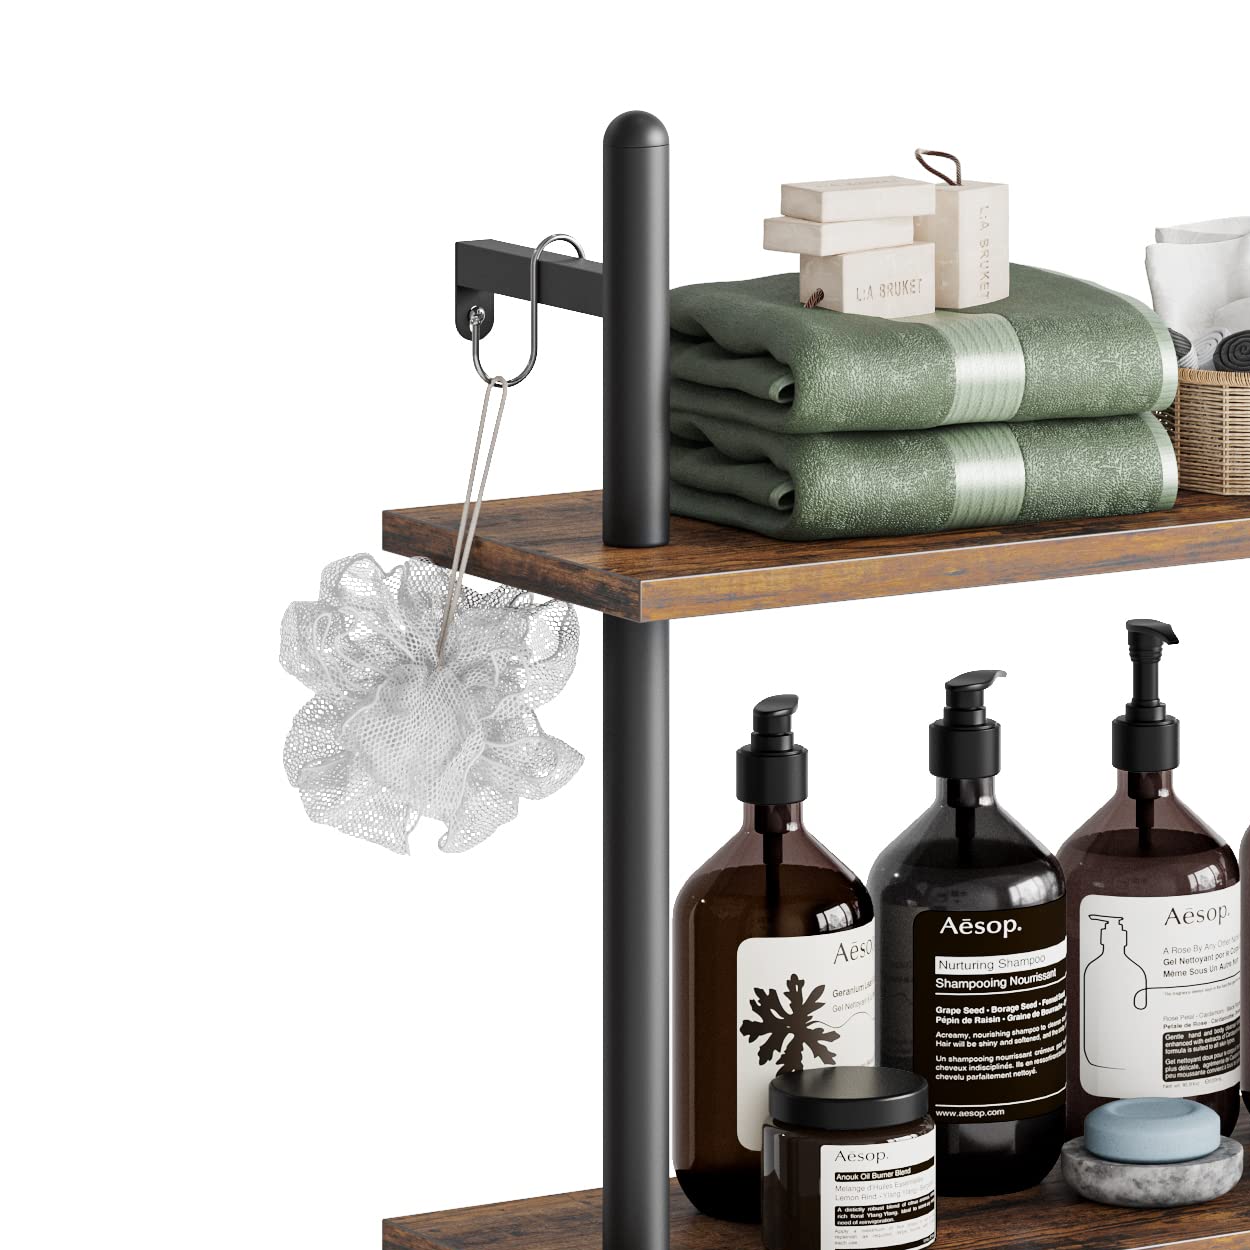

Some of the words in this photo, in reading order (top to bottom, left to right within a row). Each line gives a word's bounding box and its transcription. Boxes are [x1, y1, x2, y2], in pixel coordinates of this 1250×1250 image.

[879, 278, 923, 298] BRUKET
[938, 960, 994, 972] Nurturing
[998, 954, 1046, 969] Shampoo
[1163, 958, 1176, 966] Gel
[935, 978, 1007, 990] Shampooing
[1010, 968, 1057, 986] Nourrissant
[936, 1006, 962, 1016] Grape
[963, 1006, 985, 1014] Seed
[990, 1004, 1020, 1014] Borage
[974, 1016, 1001, 1024] Raisin
[978, 1040, 998, 1048] shiny
[936, 1108, 1005, 1118] www.aesop.com
